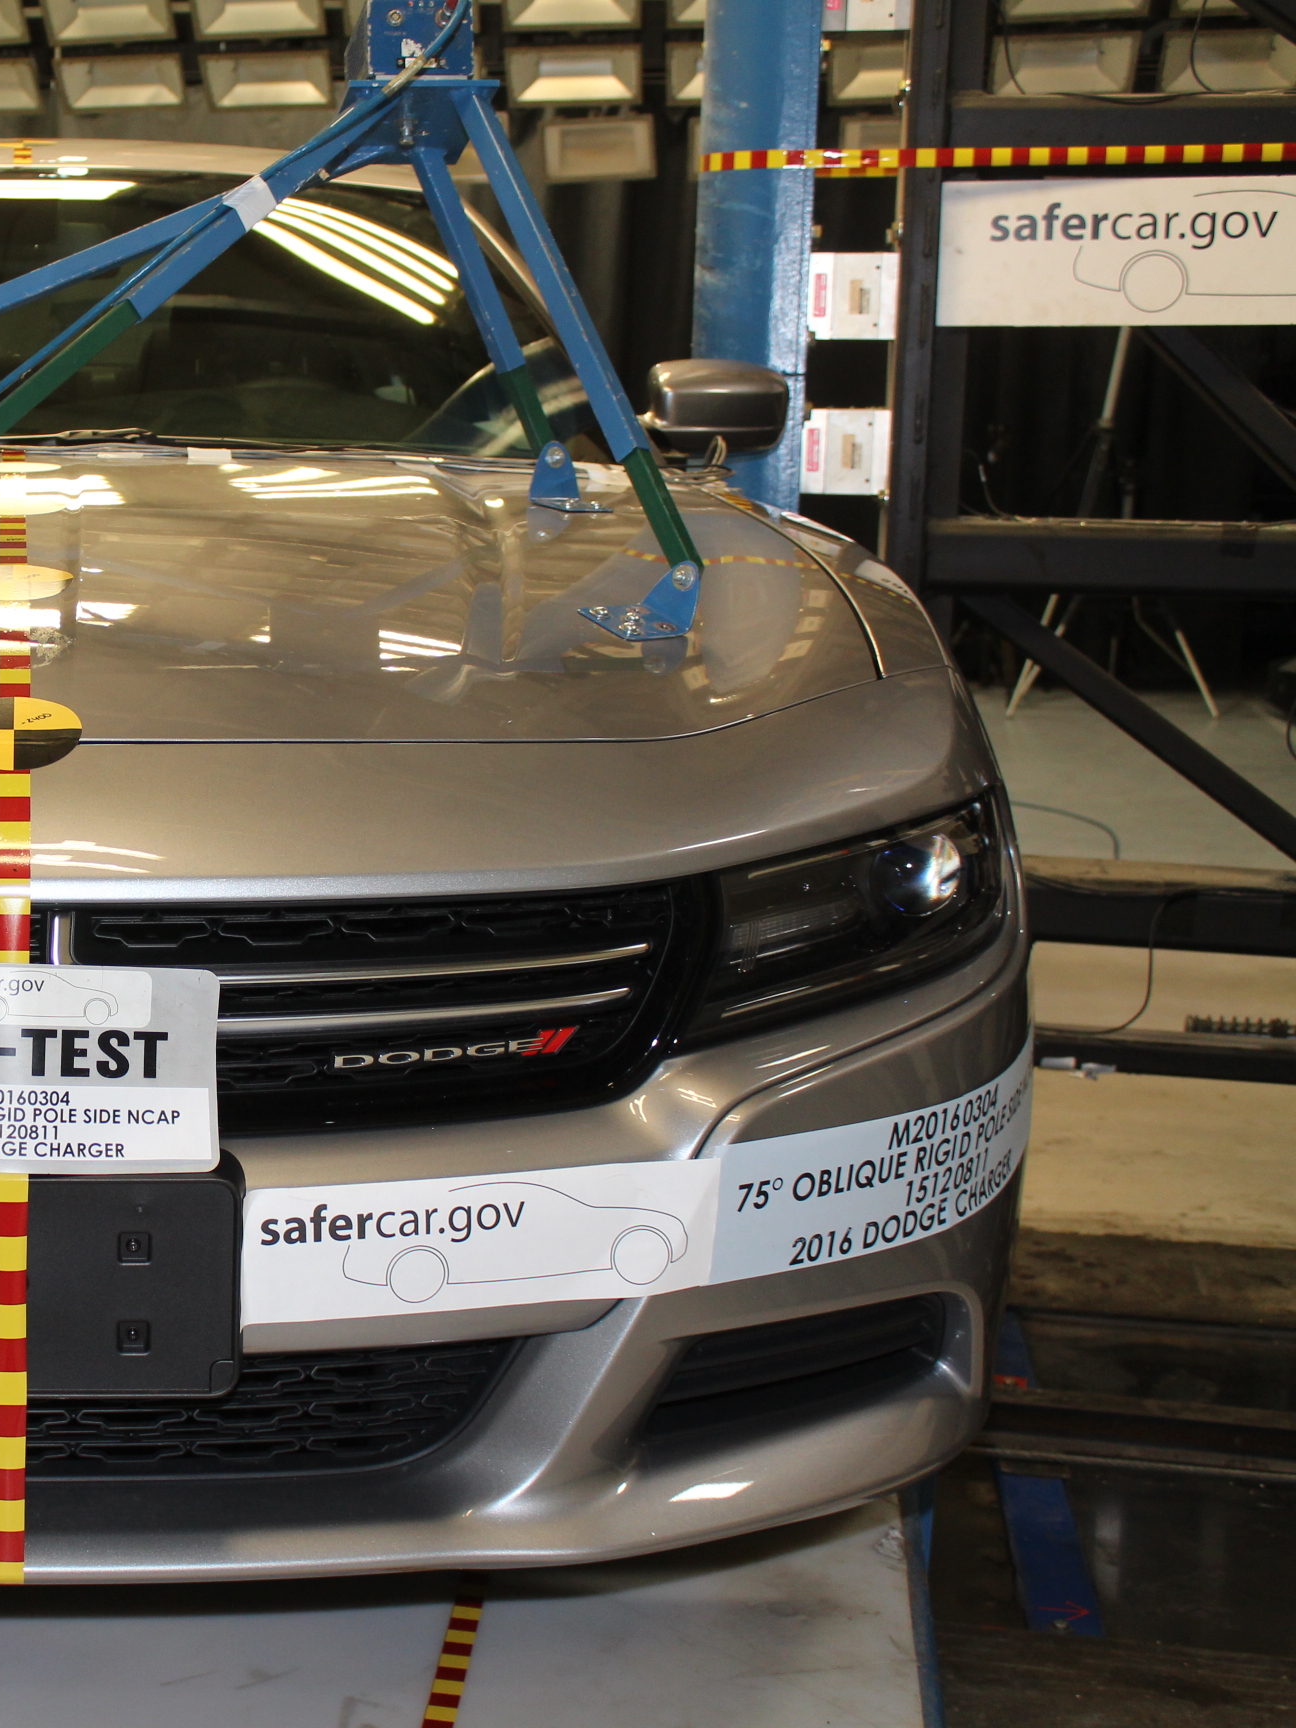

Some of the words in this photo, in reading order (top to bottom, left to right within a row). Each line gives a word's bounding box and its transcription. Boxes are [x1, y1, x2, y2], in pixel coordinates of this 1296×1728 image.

[989, 202, 1278, 250] safercar.gov
[333, 1037, 545, 1069] DODGE
[32, 1107, 77, 1124] POLE
[83, 1108, 121, 1125] SIDE
[127, 1109, 181, 1126] NCAP
[888, 1083, 999, 1151] M20160304
[33, 1140, 126, 1159] CHARGER
[737, 1176, 784, 1213] 75°
[791, 1151, 908, 1202] OBLIQUE
[914, 1131, 971, 1175] RIGID
[975, 1104, 1007, 1150] POLE
[905, 1147, 989, 1207] 15120811
[260, 1200, 526, 1247] safercar.gov
[789, 1226, 853, 1267] 2016
[863, 1197, 949, 1250] DODGE
[955, 1148, 1013, 1218] CHARGER
